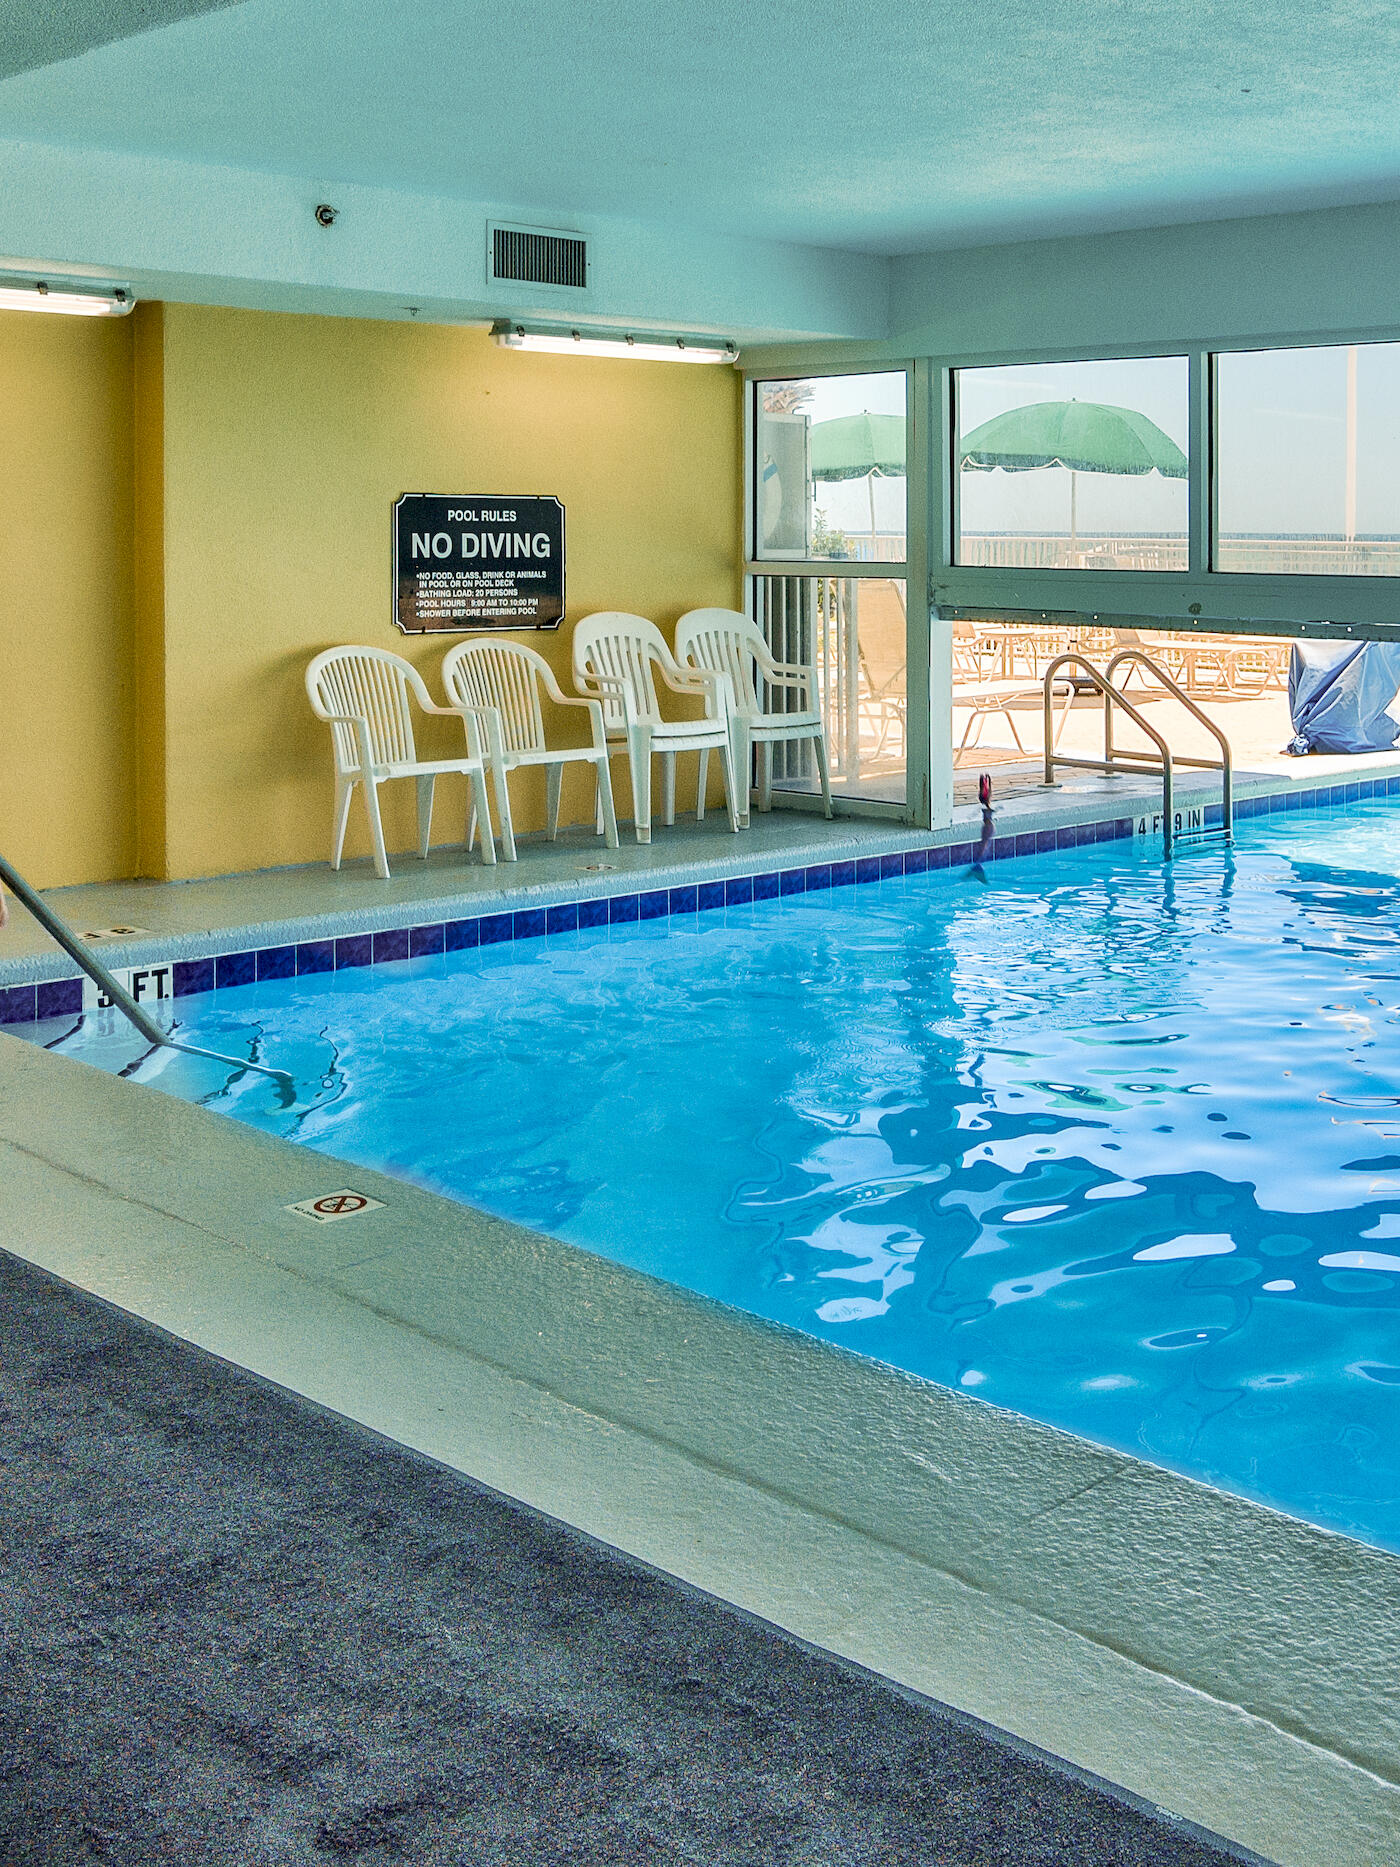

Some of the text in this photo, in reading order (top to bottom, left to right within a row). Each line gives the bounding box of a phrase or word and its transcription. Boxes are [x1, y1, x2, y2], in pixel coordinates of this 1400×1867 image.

[447, 510, 517, 522] POOL RULES
[411, 532, 551, 559] NO DIVING
[419, 571, 547, 581] NO FOOD, GLASS, DRINK OR ANIMALS
[462, 580, 473, 588] ON
[495, 579, 515, 587] DECK
[419, 588, 518, 598] BATHING LOAD: 20 PERSONS
[419, 600, 439, 608] POOL
[440, 599, 466, 608] HOURS
[486, 599, 498, 607] AM
[527, 598, 539, 606] PM
[419, 607, 537, 618] SHOWER BEFORE ENTERING POOL
[1138, 809, 1200, 835] 4 F 9 IN
[133, 968, 170, 1003] FT.
